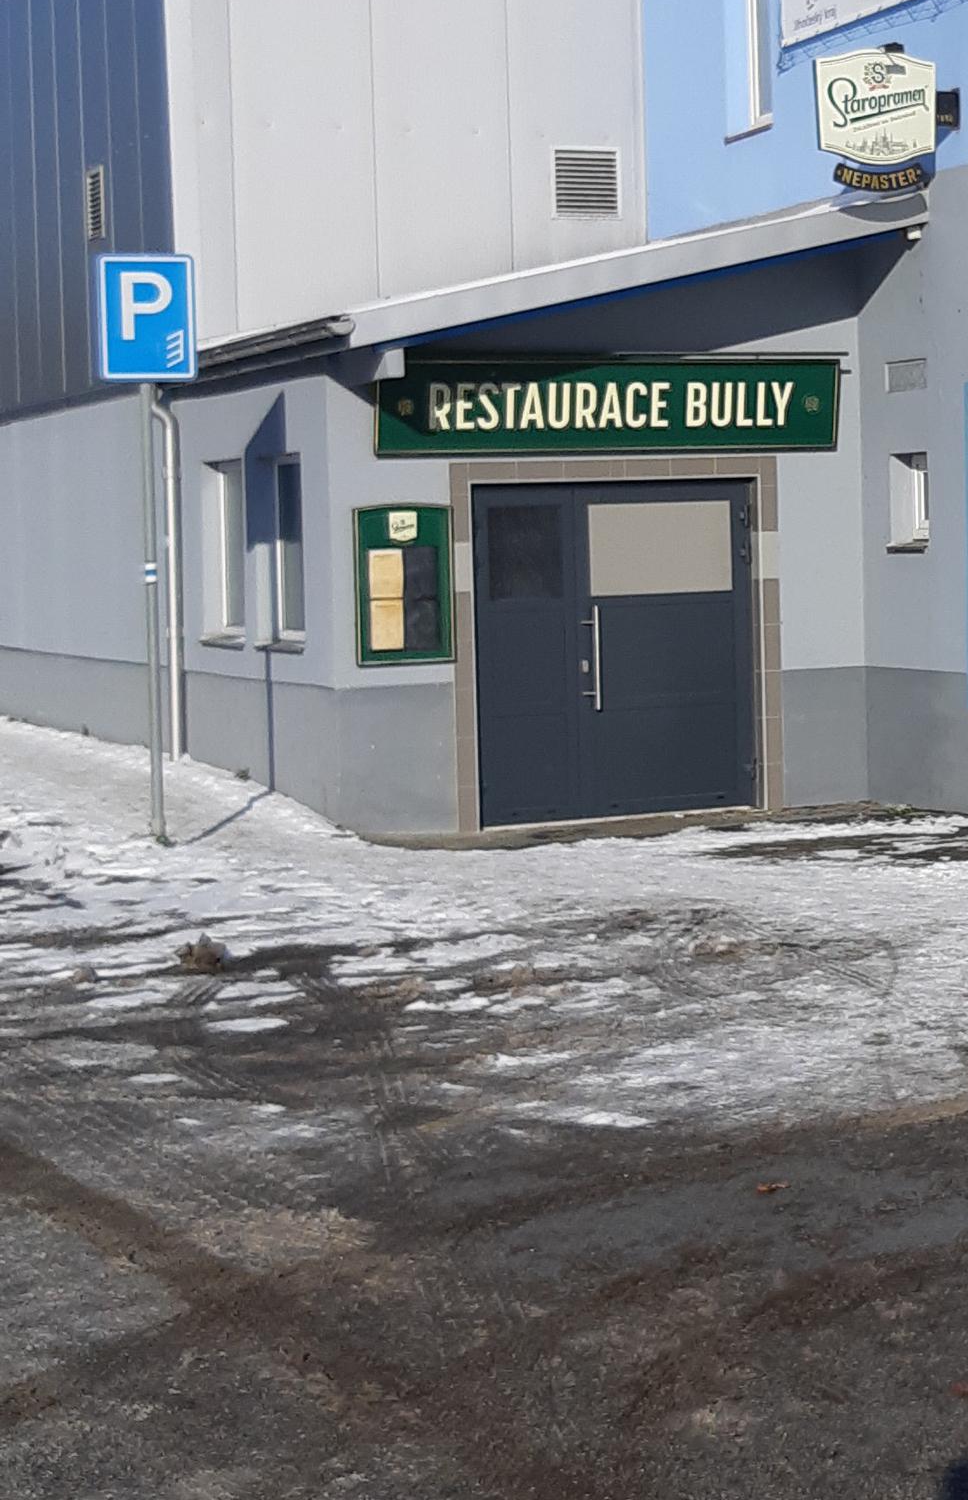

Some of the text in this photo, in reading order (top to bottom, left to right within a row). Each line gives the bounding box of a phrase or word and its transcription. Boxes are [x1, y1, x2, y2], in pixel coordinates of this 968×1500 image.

[827, 77, 926, 128] Staropramen
[841, 168, 918, 190] NEPASTER
[121, 271, 173, 340] P
[429, 381, 795, 430] RESTAURACE BULLY
